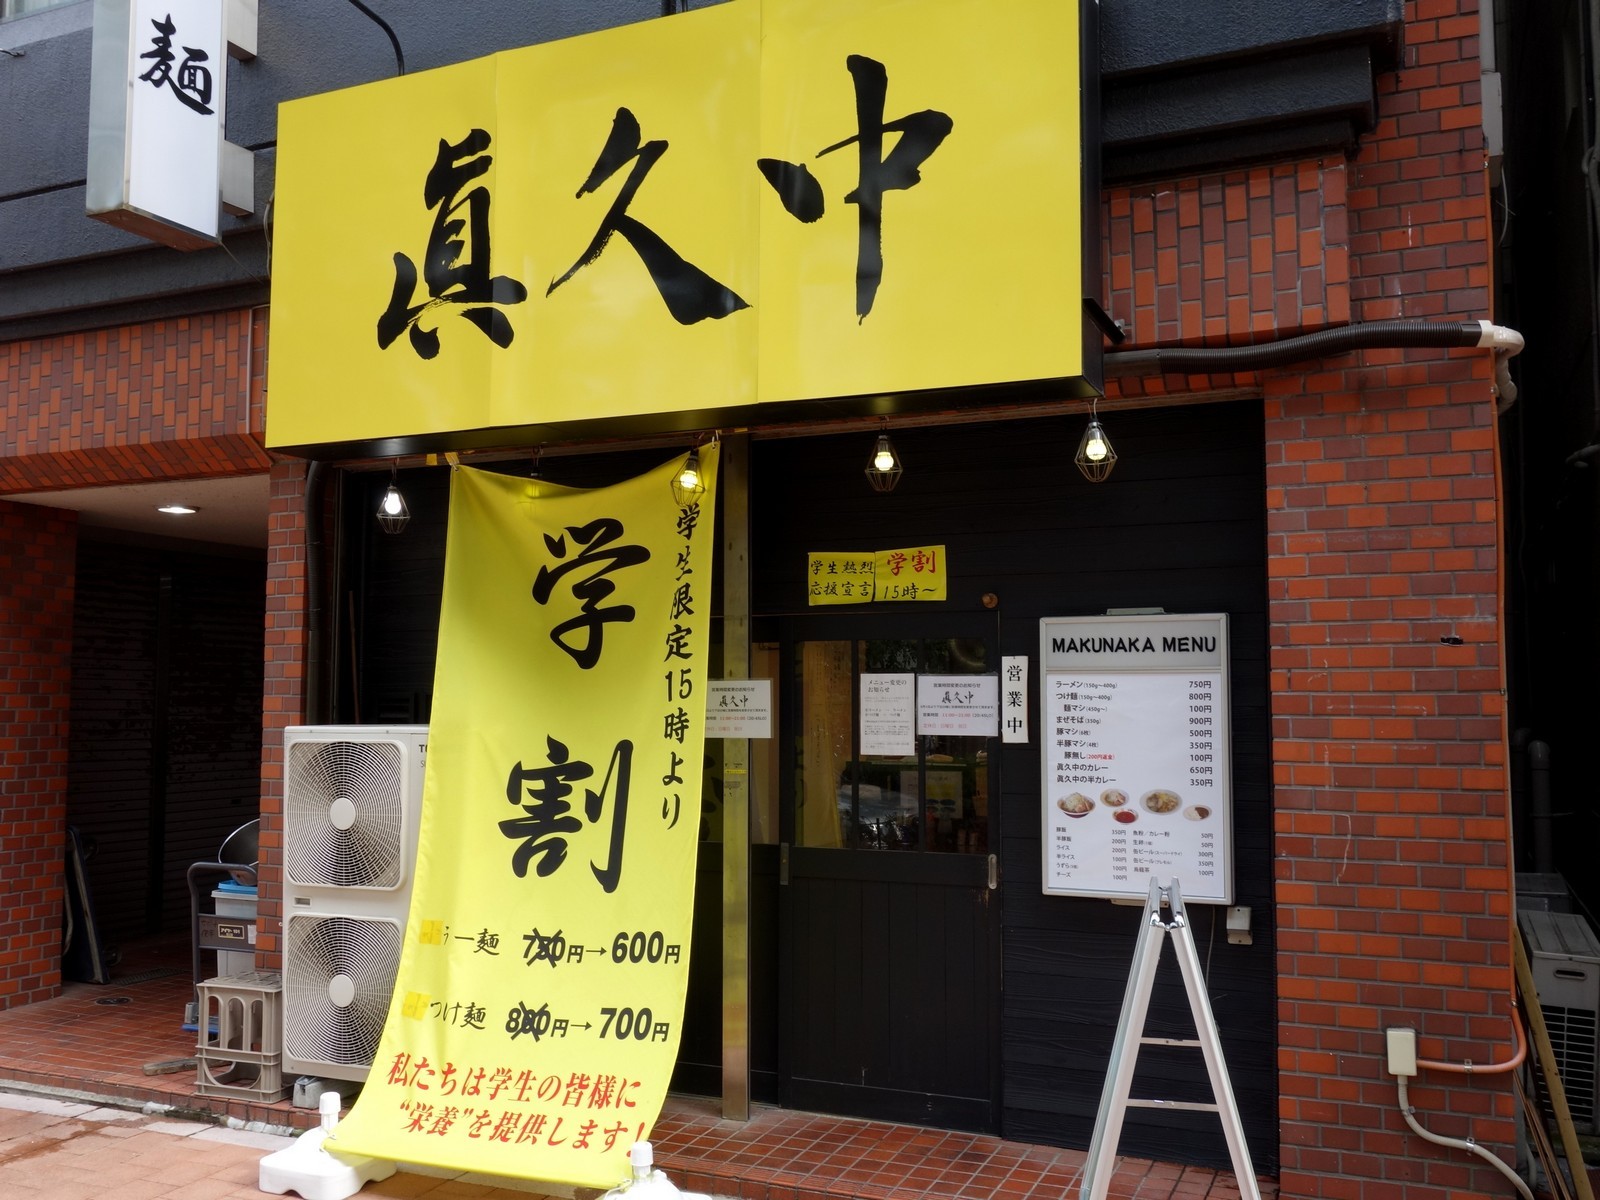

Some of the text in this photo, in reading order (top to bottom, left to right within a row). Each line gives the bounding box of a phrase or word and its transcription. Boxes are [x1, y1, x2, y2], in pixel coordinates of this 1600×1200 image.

[810, 560, 874, 575] 学生熱烈
[887, 550, 937, 576] 学割
[809, 581, 873, 596] 応援宣言
[1052, 636, 1217, 653] MAKUNAKA MENU
[661, 502, 701, 830] 学生限定15時より
[1189, 681, 1212, 689] 750円
[1007, 665, 1023, 733] 営業中
[1189, 693, 1212, 701] 800円
[497, 518, 651, 893] 学割
[1189, 705, 1212, 713] 100円
[1189, 717, 1212, 725] 900円
[1190, 742, 1212, 750] 350円
[1190, 754, 1213, 762] 100円
[1190, 766, 1213, 774] 650円
[1190, 779, 1213, 787] 350円
[612, 931, 681, 964] 600円
[430, 1002, 487, 1030] つけ麺
[599, 1007, 670, 1042] 700円
[387, 1052, 642, 1109] 私たちは学生の皆様に
